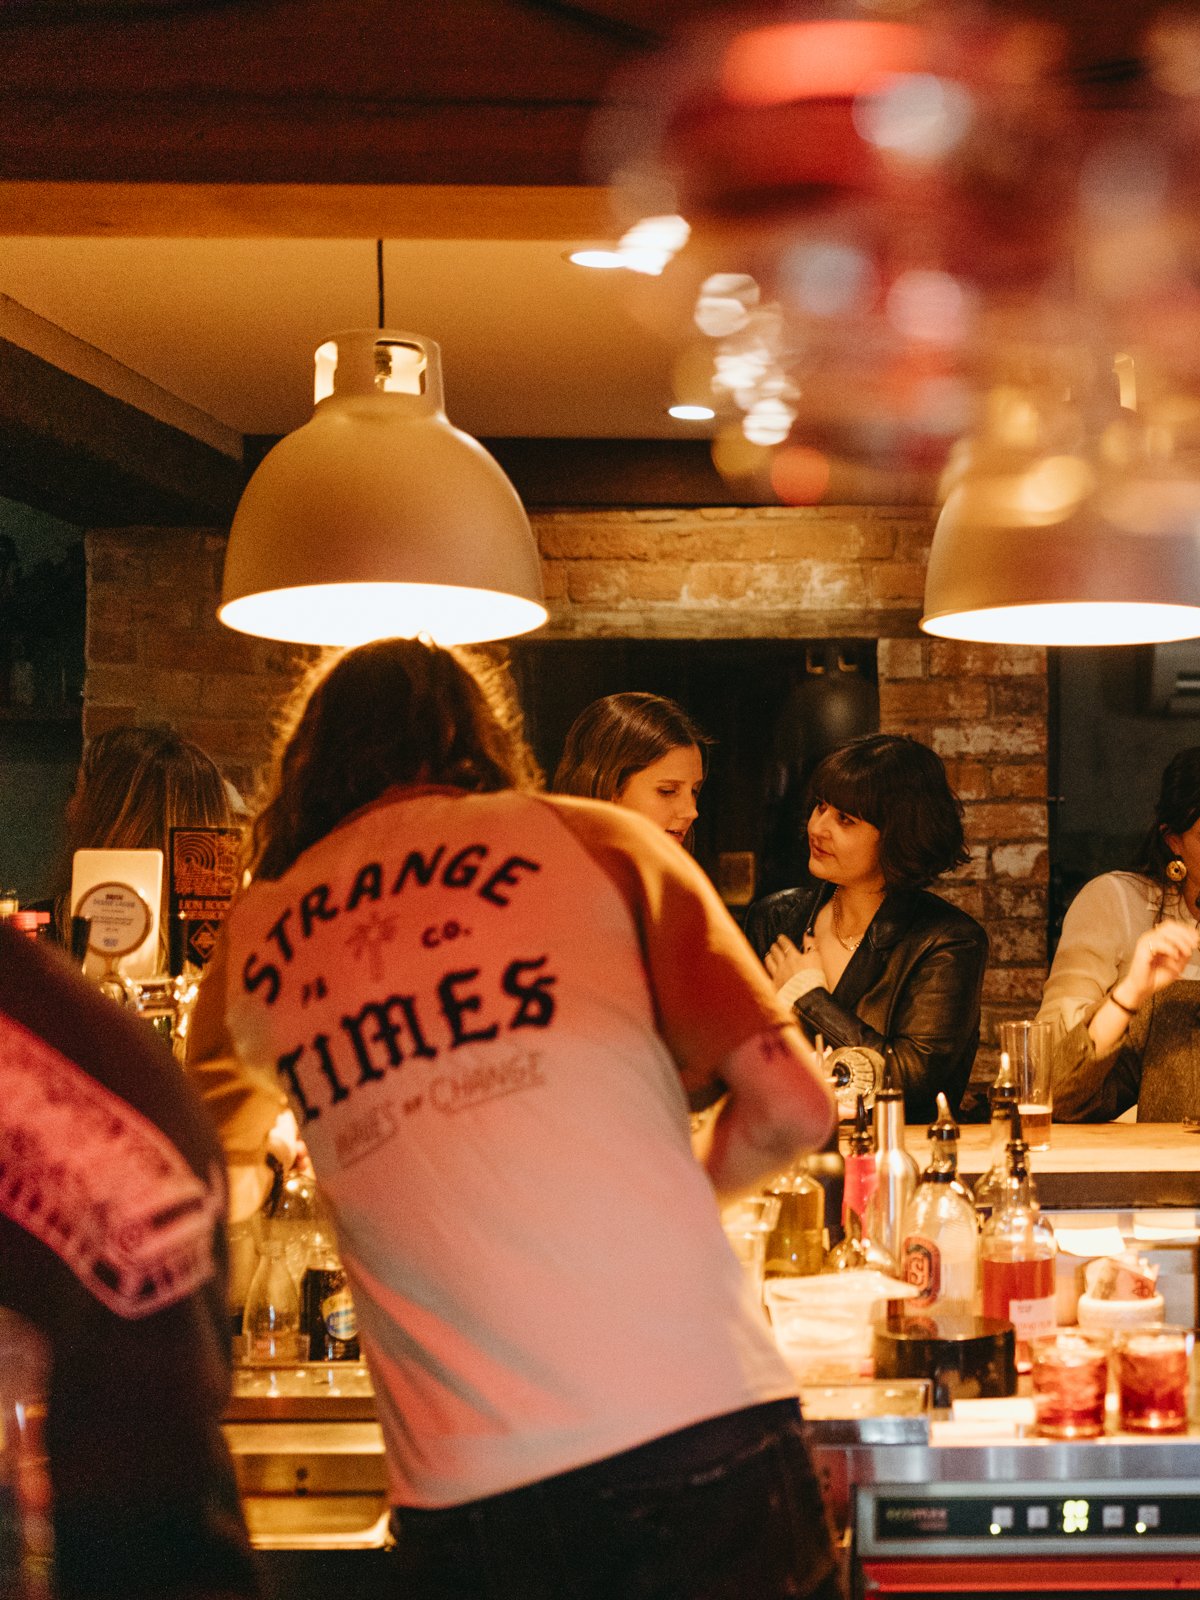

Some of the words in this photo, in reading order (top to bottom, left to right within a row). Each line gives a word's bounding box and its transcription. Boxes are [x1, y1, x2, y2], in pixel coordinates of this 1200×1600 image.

[243, 844, 541, 1005] STRANGE
[421, 920, 472, 949] CO.
[277, 954, 557, 1125] TIMES
